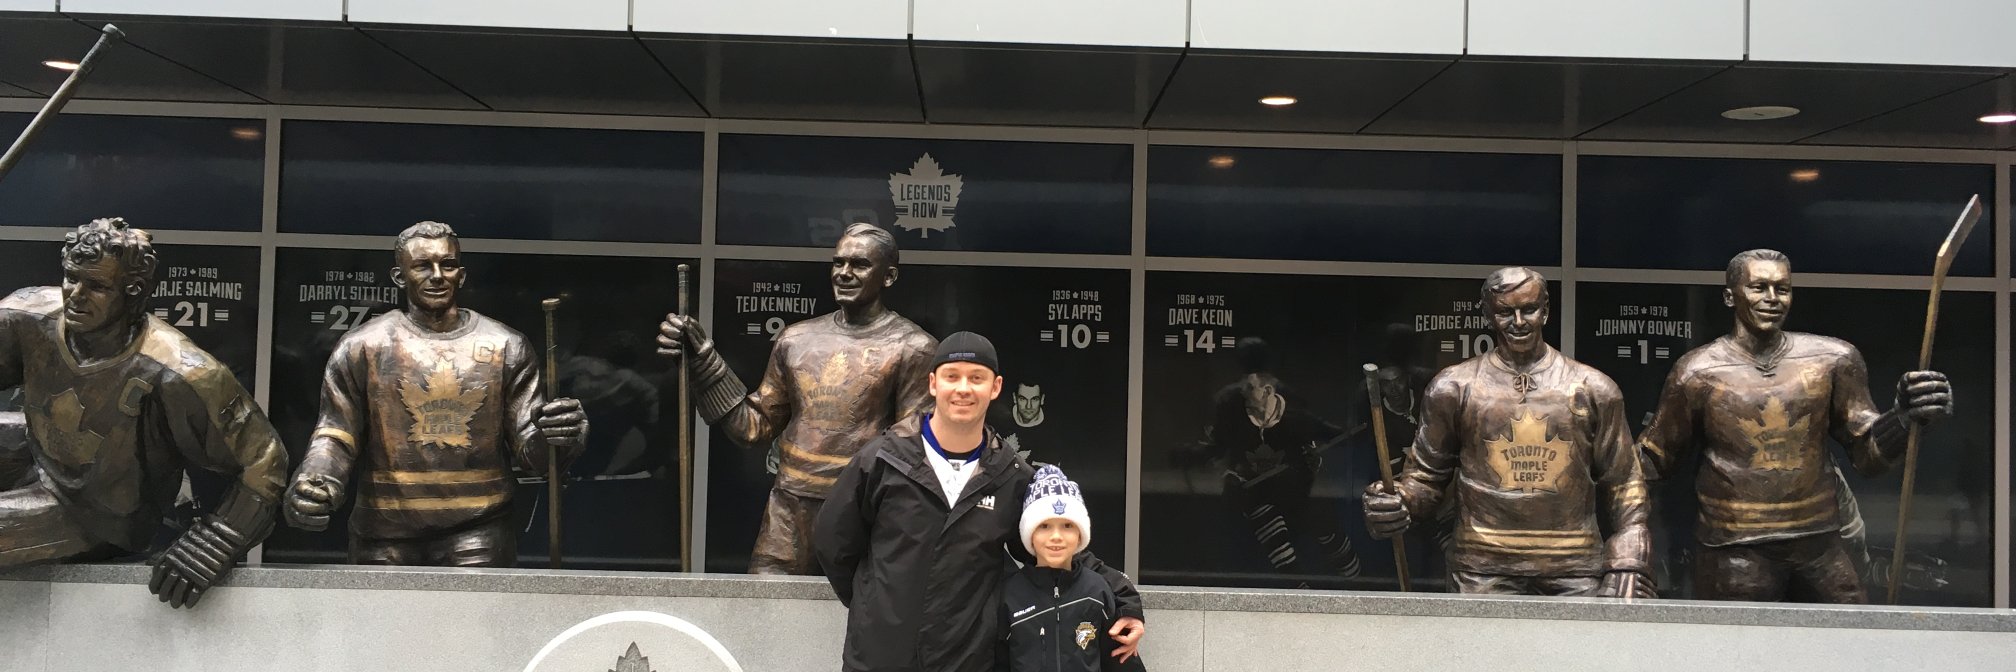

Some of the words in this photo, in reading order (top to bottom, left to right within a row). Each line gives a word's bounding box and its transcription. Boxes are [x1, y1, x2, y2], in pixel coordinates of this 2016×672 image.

[900, 184, 951, 201] LEGENDS
[912, 202, 938, 218] ROW
[168, 266, 188, 278] 1973
[198, 267, 218, 279] 1989
[355, 271, 375, 283] 1982
[185, 281, 242, 301] SALMING
[299, 284, 347, 302] DARRYL
[349, 286, 398, 305] SITTLER
[752, 282, 772, 293] 1942
[782, 283, 801, 294] 1957
[1052, 290, 1071, 301] 1936
[1080, 290, 1099, 302] 1948
[736, 295, 758, 313] TED
[760, 297, 817, 315] KENNEDY
[1206, 295, 1225, 306] 1975
[1453, 301, 1472, 312] 1949
[173, 300, 208, 327] 21
[329, 304, 370, 331] 27
[1048, 303, 1070, 321] SYL
[1071, 304, 1102, 322] APPS
[1168, 308, 1199, 326] DAVE
[1201, 308, 1233, 327] KEON
[765, 316, 786, 341] 9
[1415, 314, 1462, 332] GEORGE
[1595, 319, 1646, 336] JOHNNY
[1647, 320, 1692, 339] BOWER
[1057, 323, 1092, 349] 10
[1183, 329, 1216, 353] 14
[1459, 333, 1495, 359] 10
[1637, 339, 1648, 364] 1
[1500, 445, 1557, 462] TORONTO
[1511, 461, 1548, 471] MAPLE
[1513, 472, 1545, 482] LEAFS
